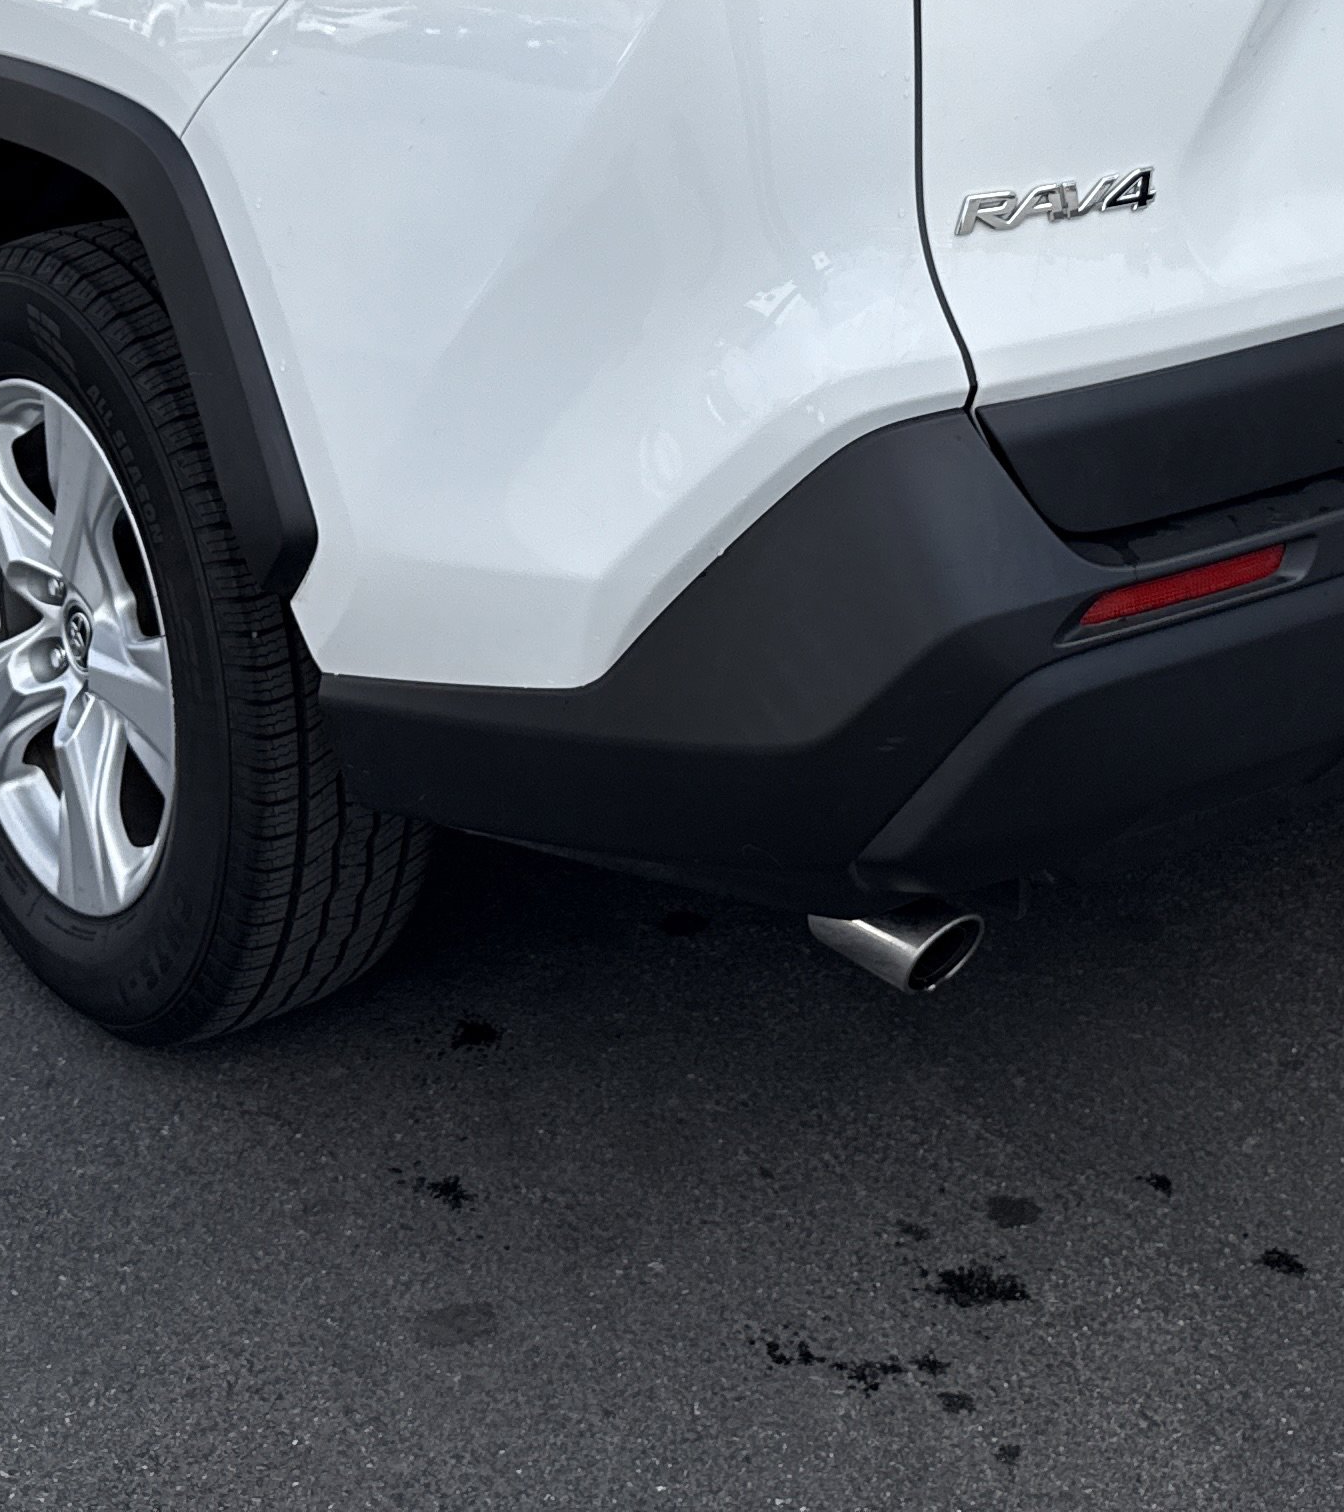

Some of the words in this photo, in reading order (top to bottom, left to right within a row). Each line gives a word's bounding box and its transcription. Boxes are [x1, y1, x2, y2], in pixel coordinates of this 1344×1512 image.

[953, 165, 1157, 237] RAV4
[86, 384, 113, 428] ALL
[112, 428, 164, 545] SEASON
